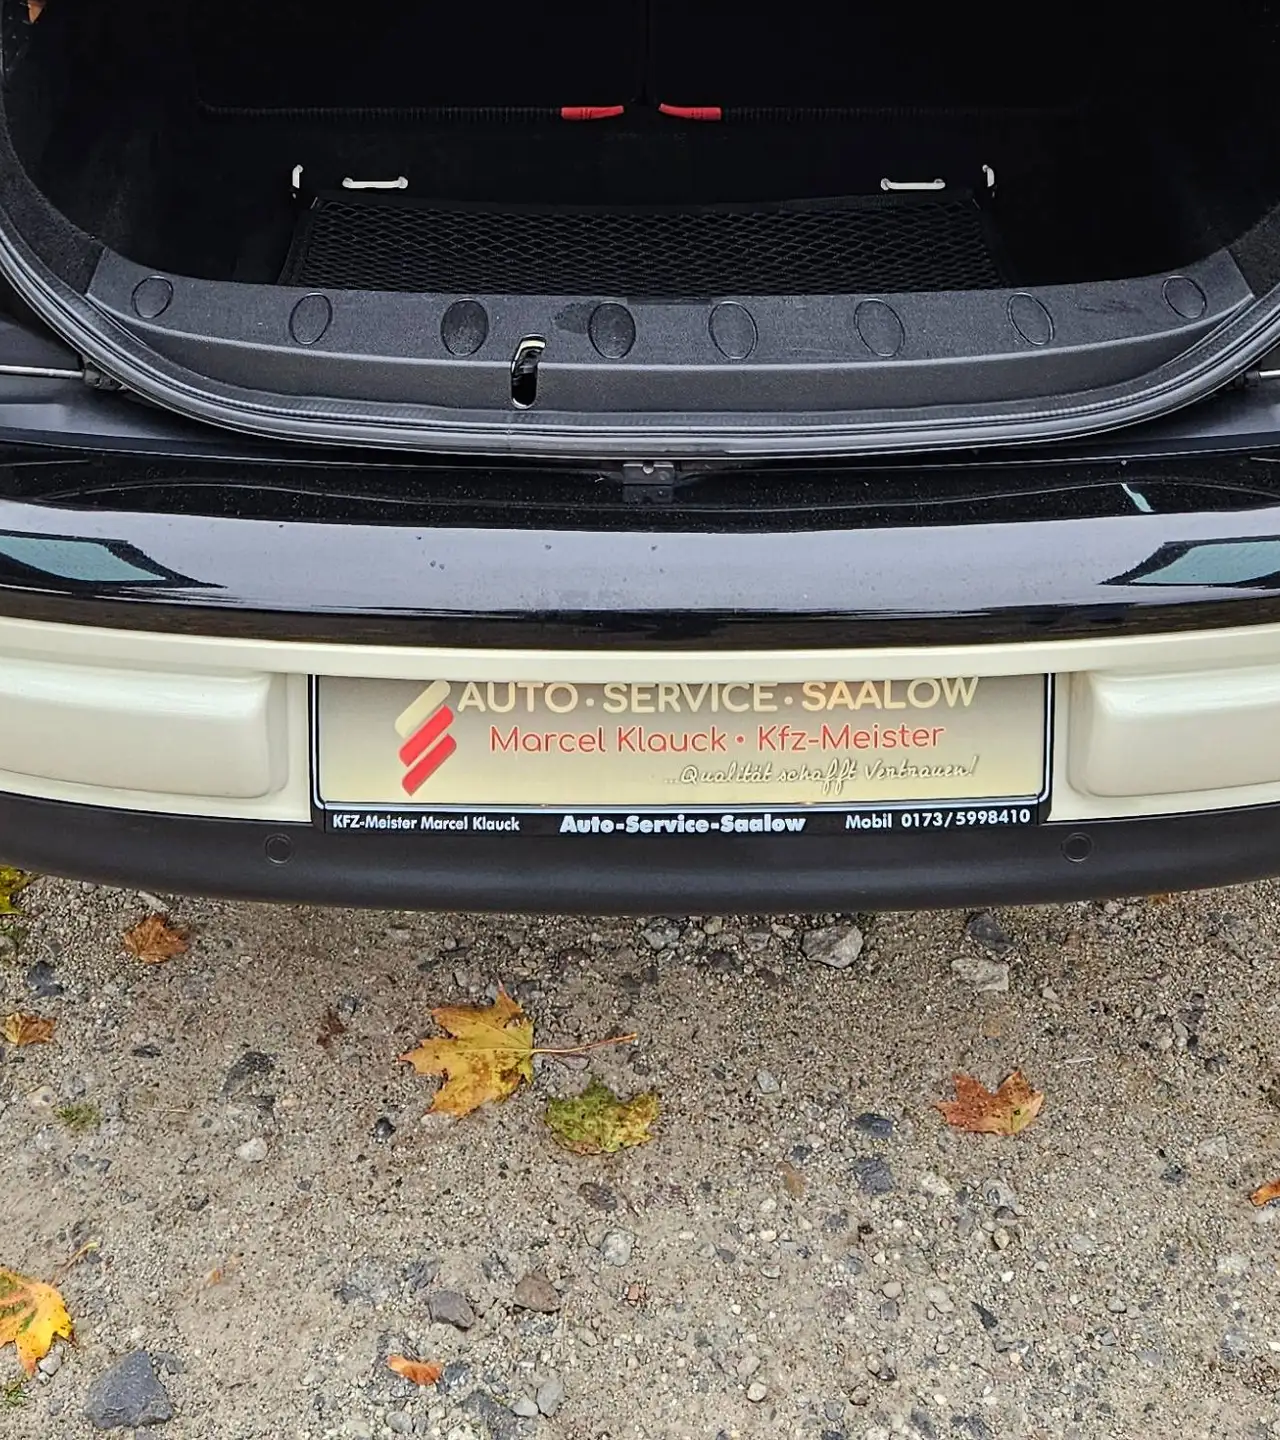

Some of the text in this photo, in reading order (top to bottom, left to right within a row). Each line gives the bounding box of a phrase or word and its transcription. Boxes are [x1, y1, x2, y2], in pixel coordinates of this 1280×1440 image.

[456, 675, 980, 713] AUTO SERVICE SAALOW
[489, 722, 946, 753] Marcel Klauck Kfz-Meister
[776, 756, 857, 795] schafft
[863, 755, 980, 781] Vertrauen!
[332, 808, 1032, 834] KFZ-Meister Marcel Klauck Auto-Service-Saalow Mobil 0173/5998410
